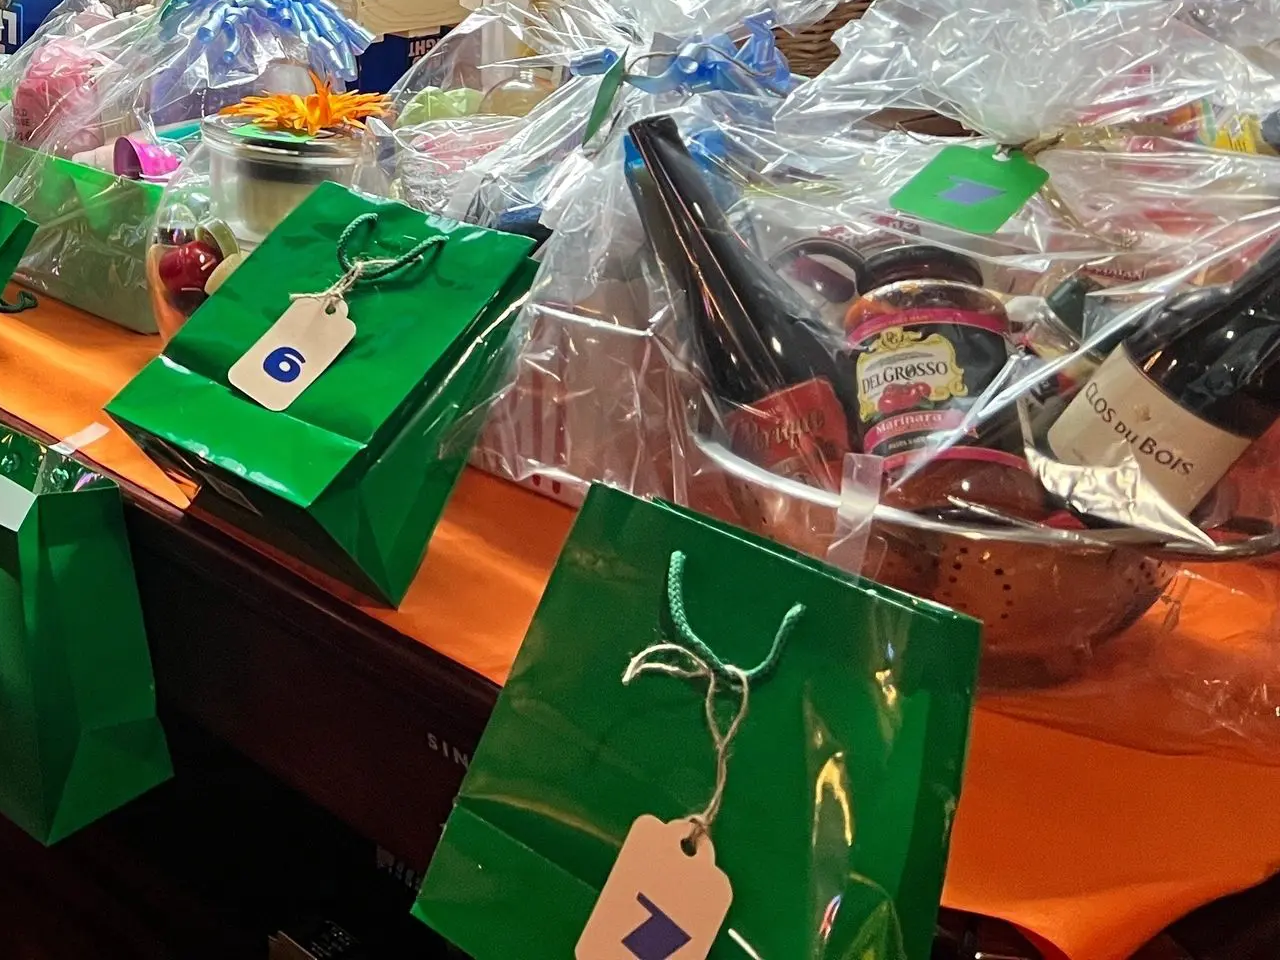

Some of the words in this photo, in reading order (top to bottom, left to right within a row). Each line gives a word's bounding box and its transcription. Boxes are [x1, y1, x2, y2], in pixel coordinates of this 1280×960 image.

[263, 347, 306, 383] 6
[862, 361, 949, 394] DELGROSSO
[876, 412, 944, 435] Marinara
[1085, 382, 1117, 423] CLOS
[1138, 436, 1194, 475] BOIS
